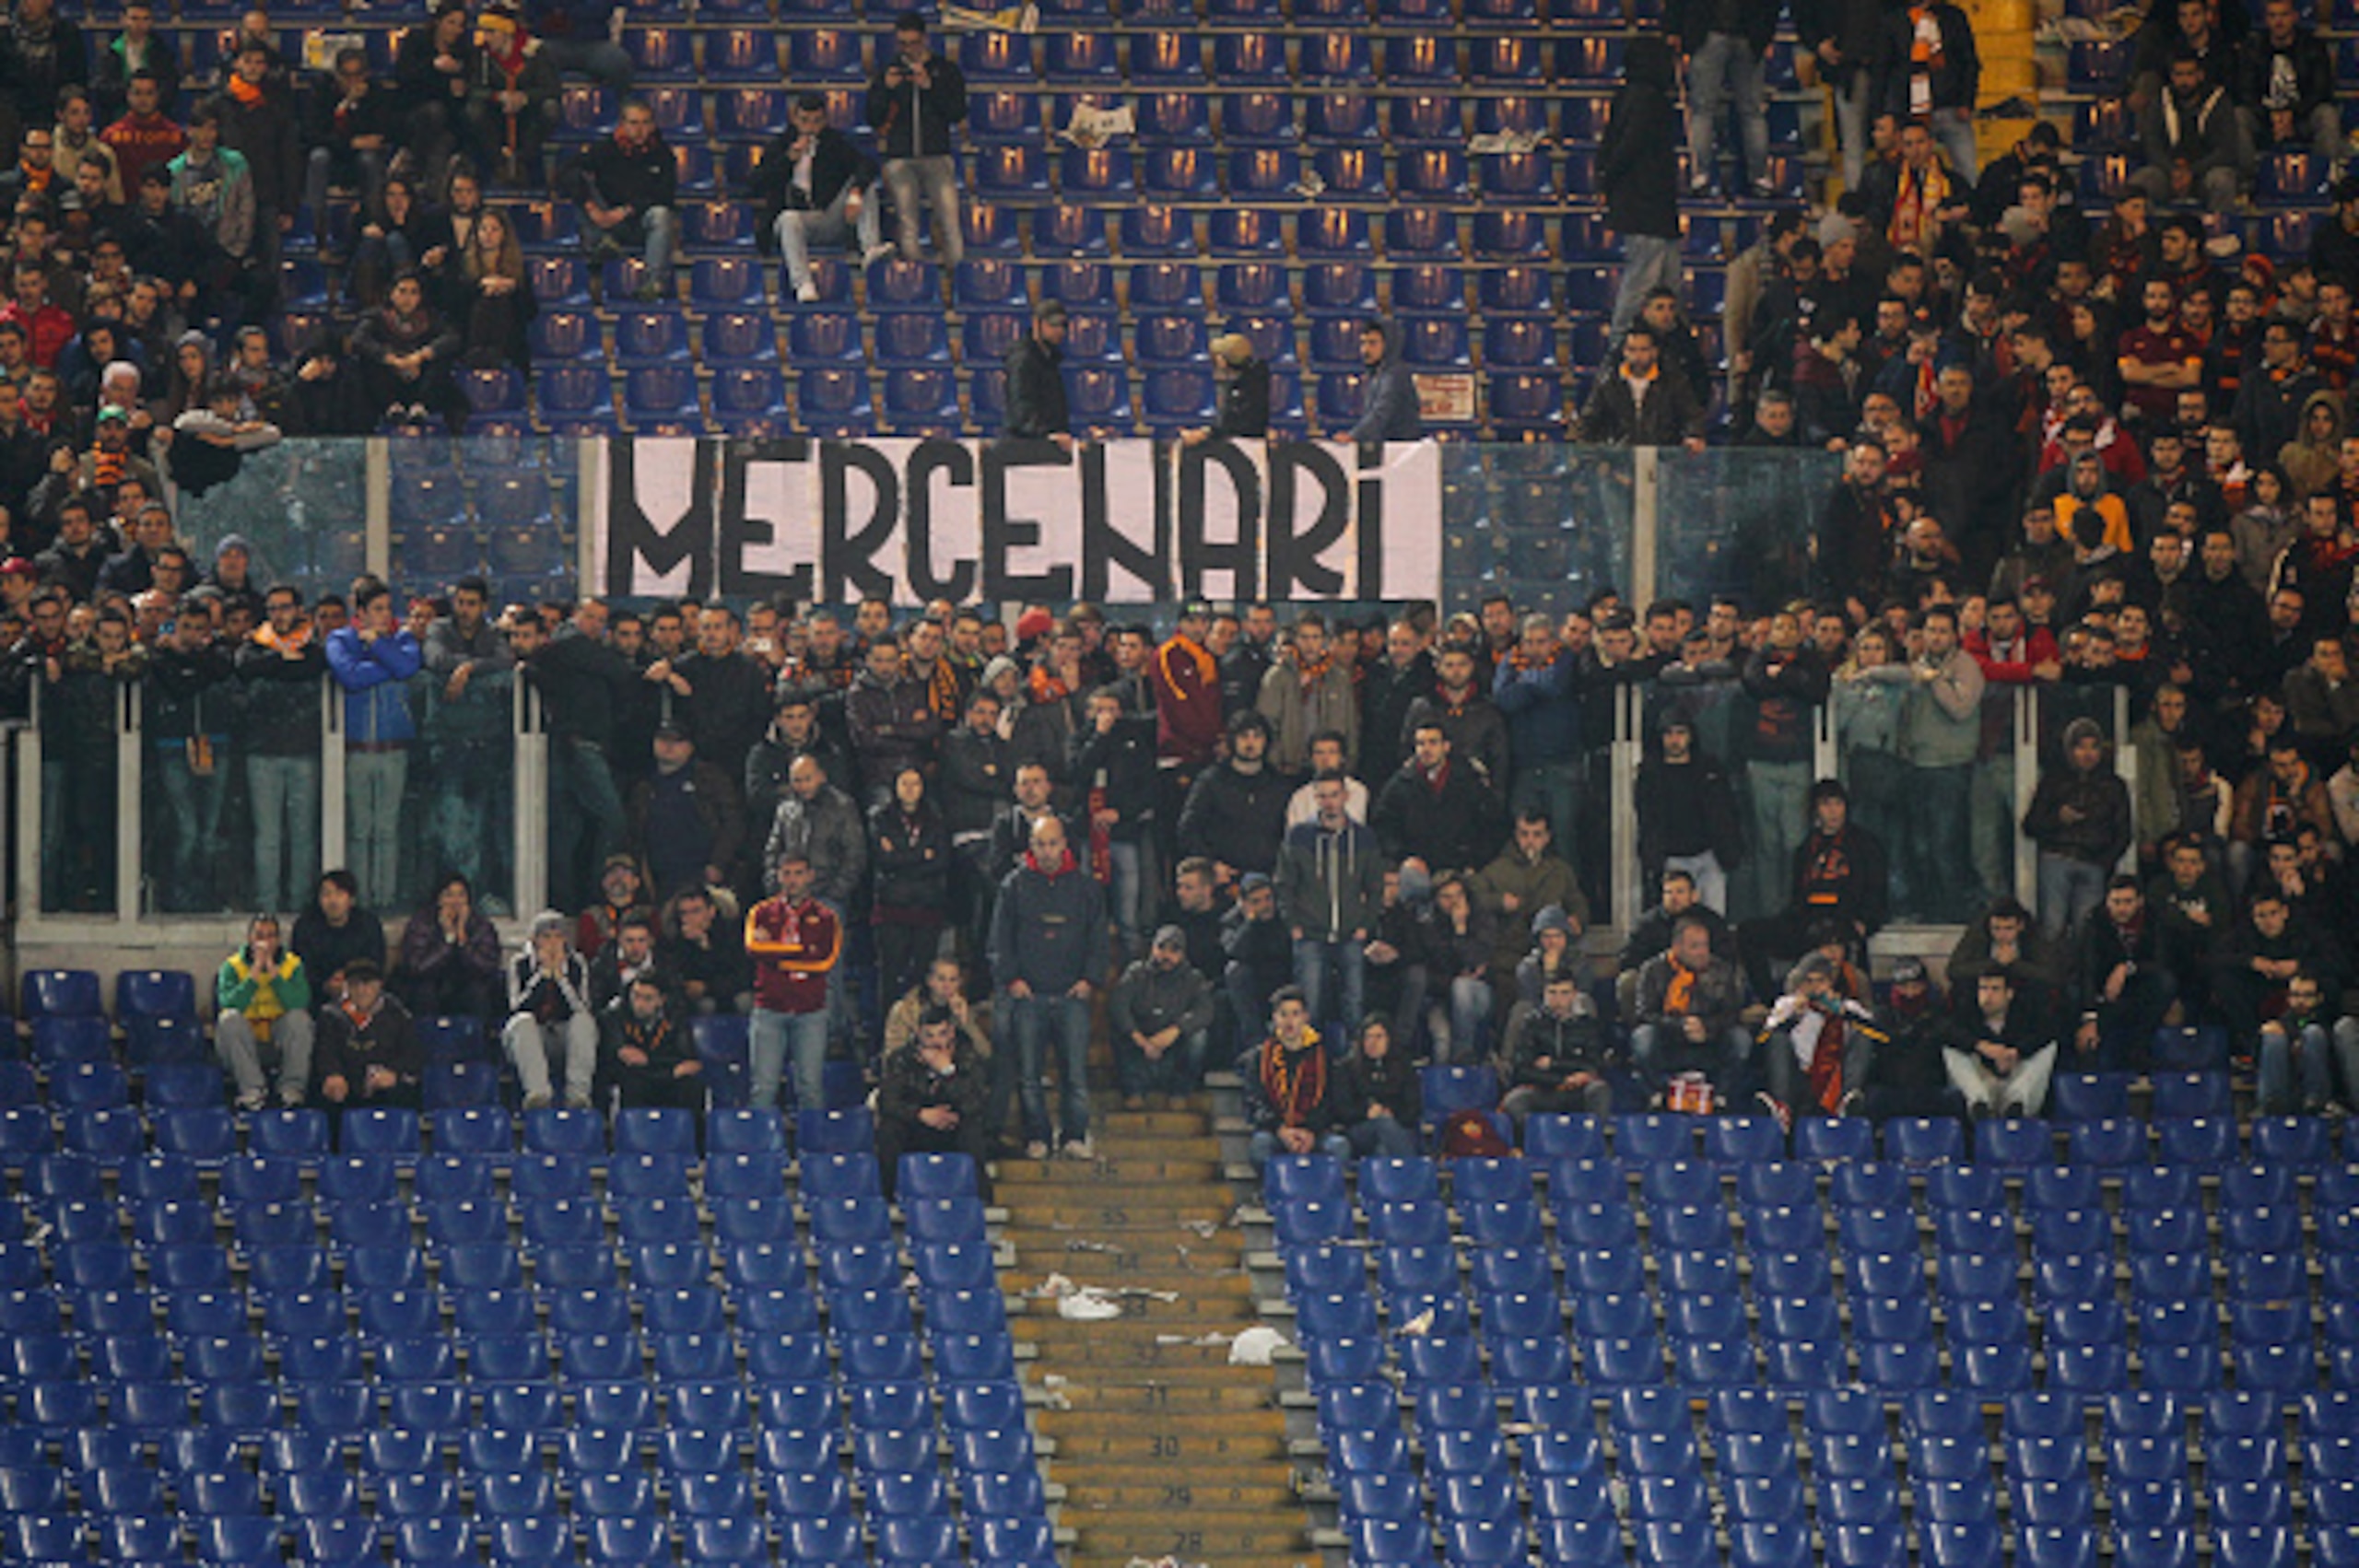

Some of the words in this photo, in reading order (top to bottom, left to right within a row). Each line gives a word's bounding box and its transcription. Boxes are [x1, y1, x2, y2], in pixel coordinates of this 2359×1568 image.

[1143, 1385, 1168, 1406] 31
[1148, 1434, 1180, 1457] 30
[1162, 1484, 1192, 1506] 29
[1173, 1530, 1203, 1553] 28
